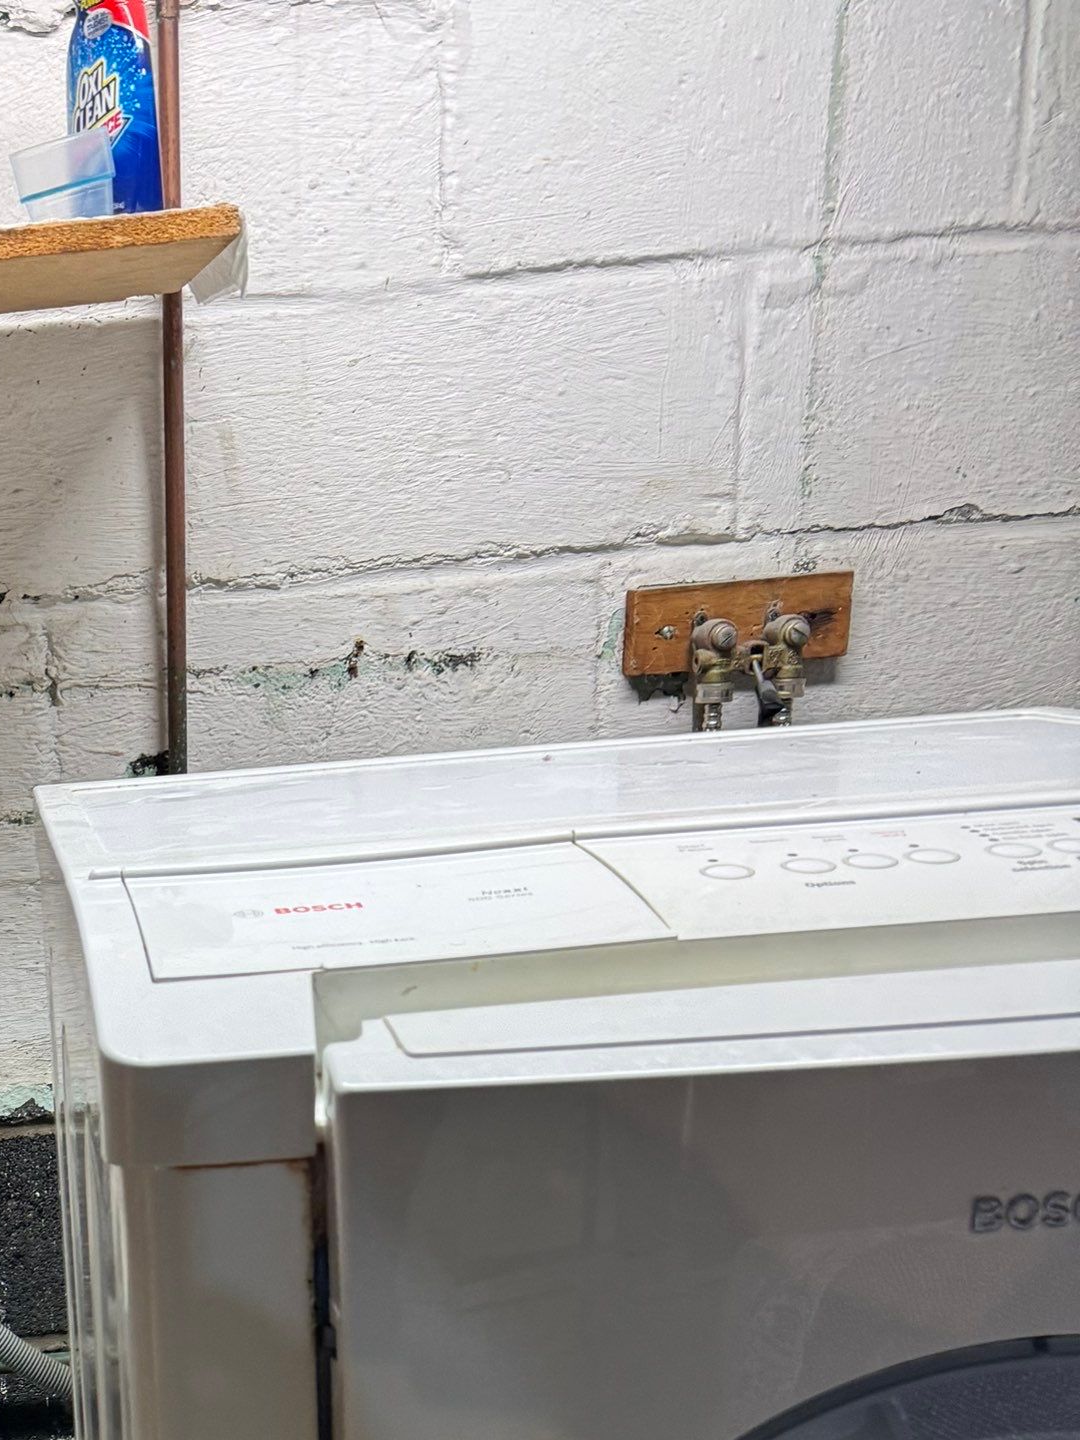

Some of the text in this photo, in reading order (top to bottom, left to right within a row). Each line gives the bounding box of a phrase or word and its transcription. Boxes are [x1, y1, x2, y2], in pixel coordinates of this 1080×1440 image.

[79, 61, 104, 107] OXI
[274, 902, 363, 914] BOSCH
[970, 1190, 1080, 1233] BOS
